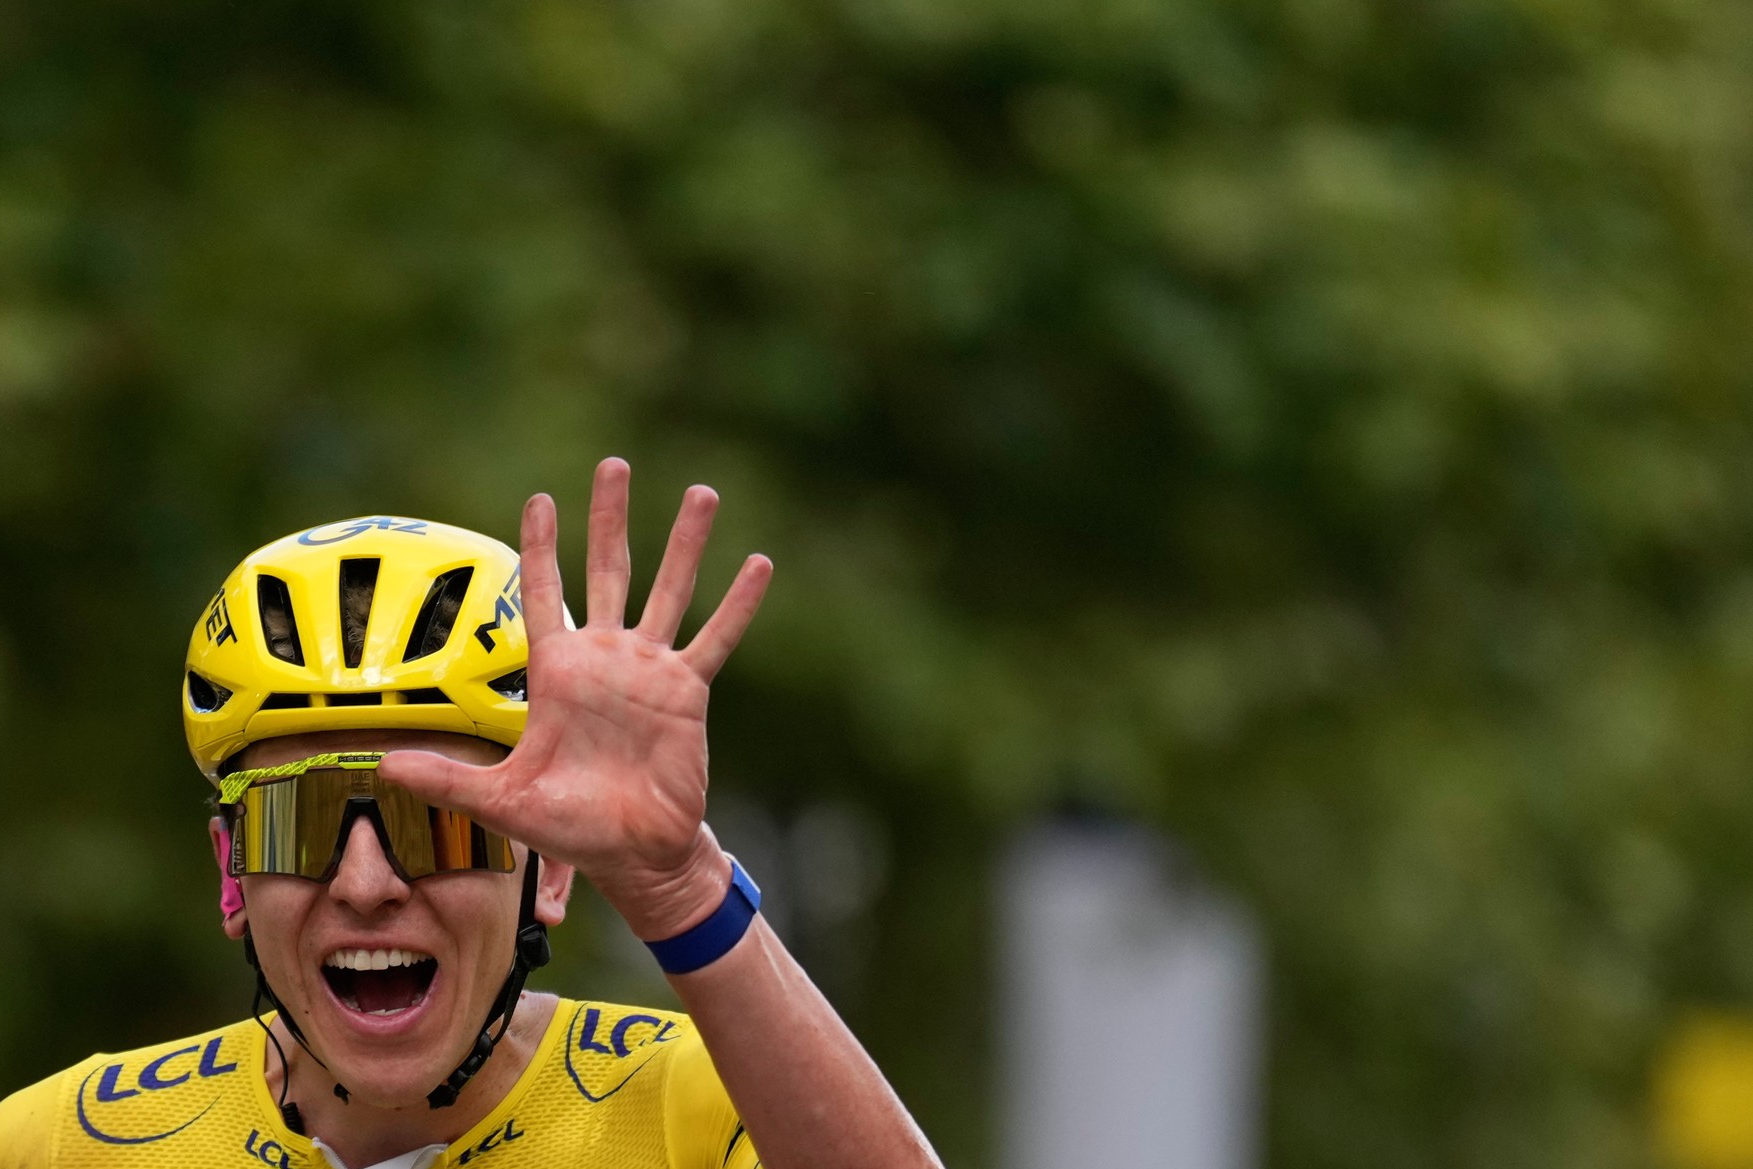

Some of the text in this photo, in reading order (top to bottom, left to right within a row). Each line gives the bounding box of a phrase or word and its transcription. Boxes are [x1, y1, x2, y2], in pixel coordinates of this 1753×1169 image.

[205, 588, 238, 647] ET
[577, 1007, 682, 1058] LCL
[95, 1036, 238, 1102] LCL
[459, 1118, 525, 1166] LCL
